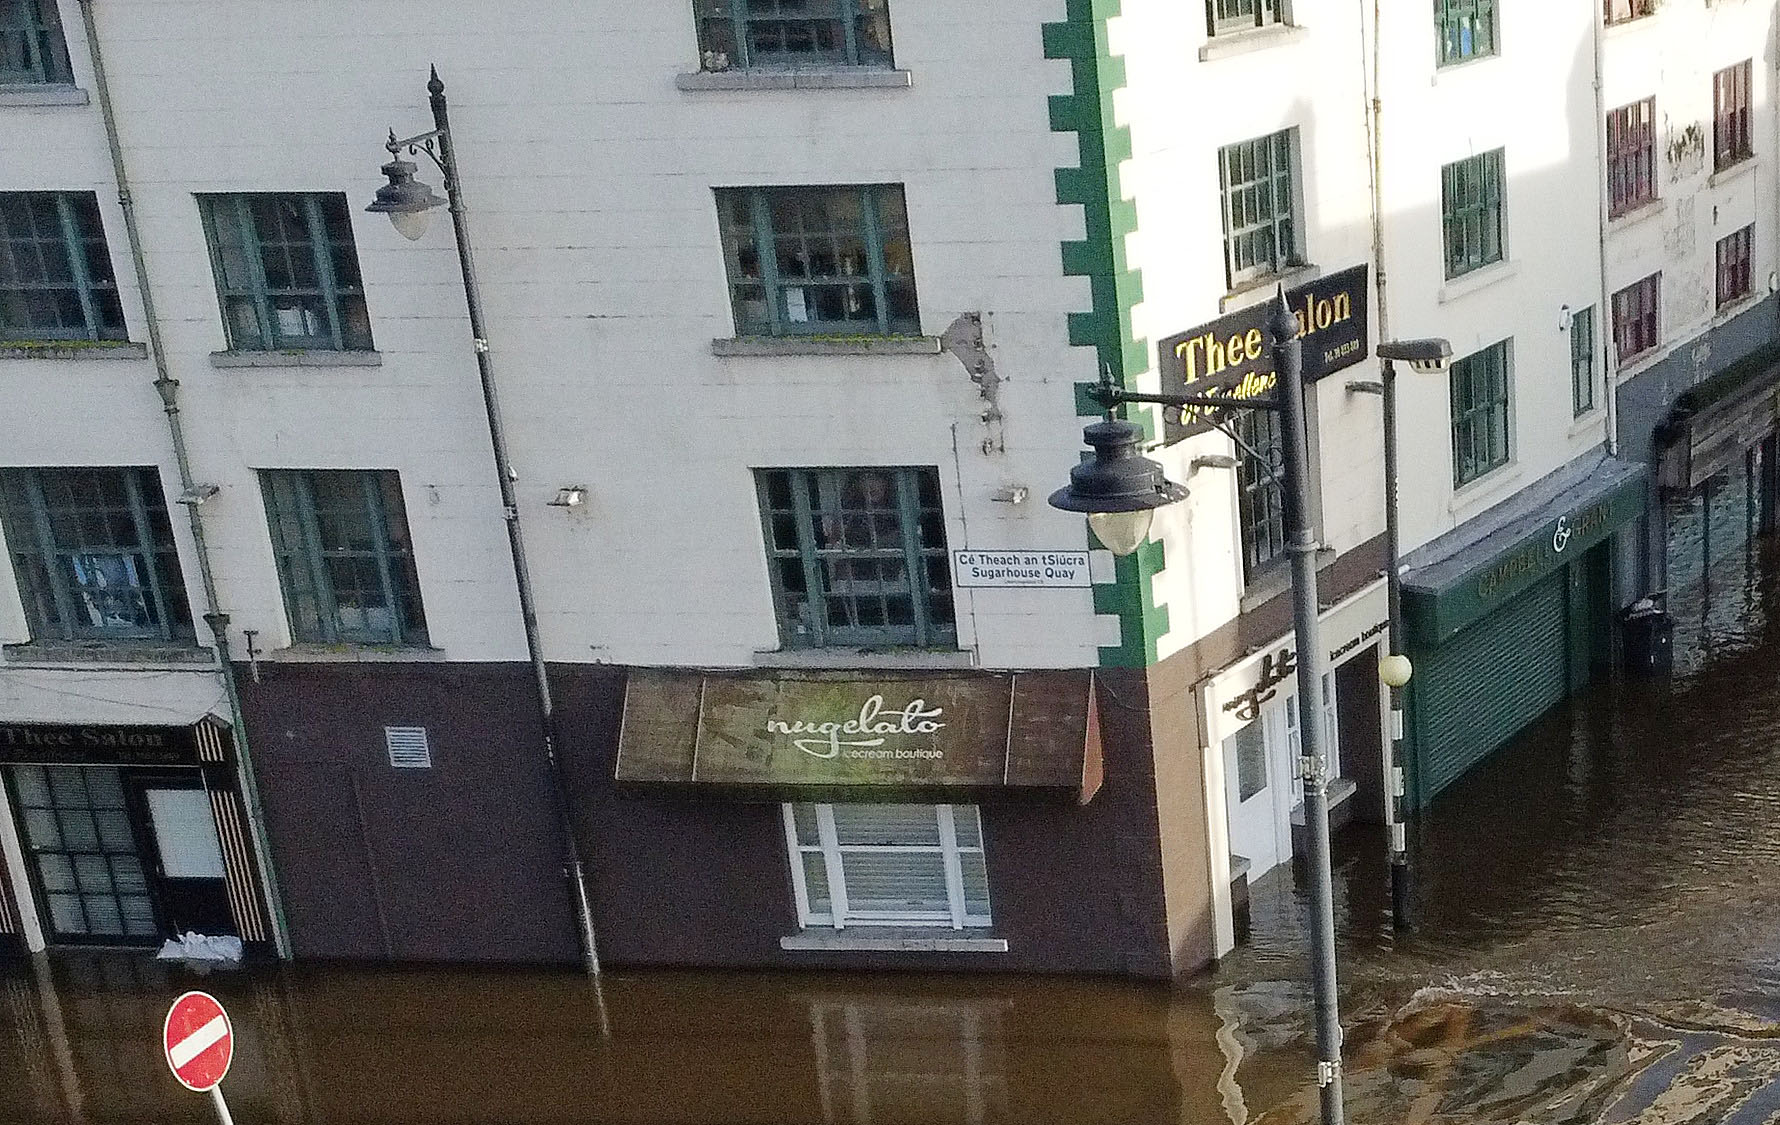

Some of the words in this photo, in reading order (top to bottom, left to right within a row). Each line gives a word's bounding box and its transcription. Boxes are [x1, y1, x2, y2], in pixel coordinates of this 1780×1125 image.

[1175, 326, 1263, 386] Thee
[1553, 515, 1572, 553] &
[960, 553, 976, 566] Cé
[978, 553, 1022, 566] Theach
[1024, 555, 1039, 566] an
[1042, 553, 1085, 567] tSiúcra
[971, 567, 1041, 580] Sugarhouse
[1044, 567, 1076, 580] Quay
[767, 694, 947, 759] nugelato
[2, 727, 73, 746] Thee
[81, 728, 163, 748] Salon
[895, 748, 944, 762] boutique
